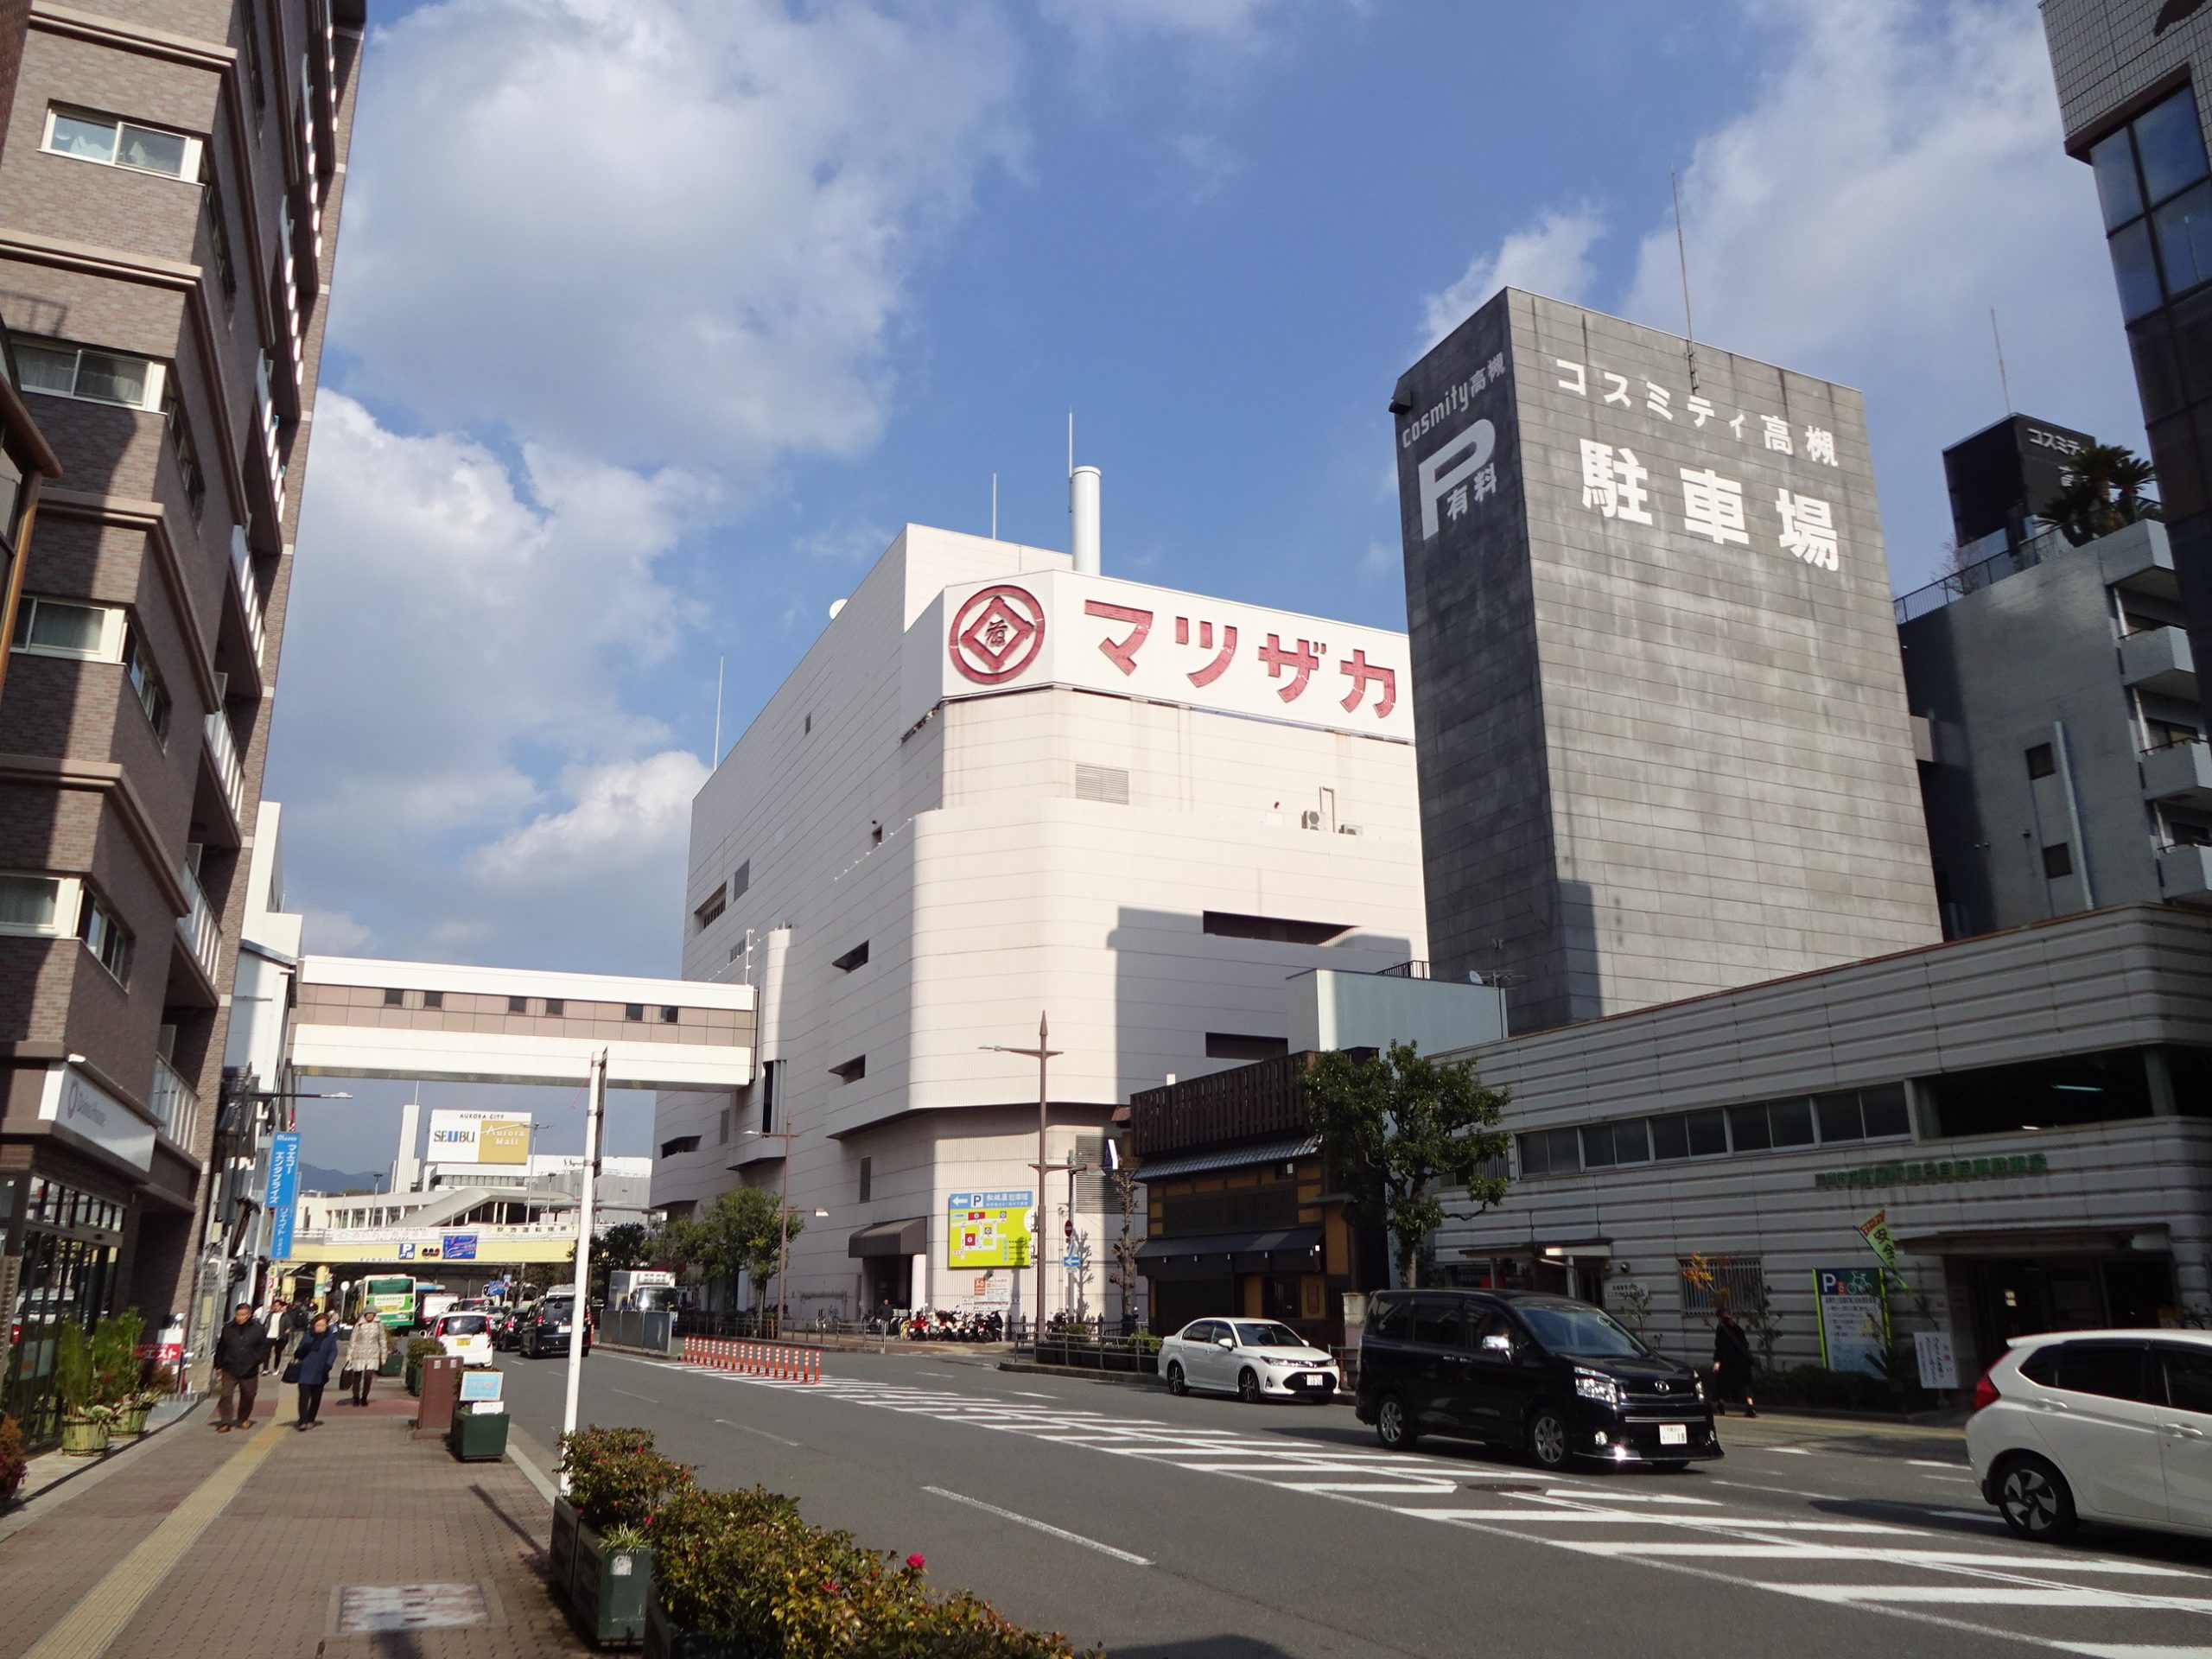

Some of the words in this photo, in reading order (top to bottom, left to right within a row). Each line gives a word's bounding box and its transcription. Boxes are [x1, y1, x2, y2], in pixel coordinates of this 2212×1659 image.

[1555, 358, 1839, 467] コスミティ高槻
[1417, 418, 1497, 541] P
[1446, 462, 1497, 521] 有料
[1579, 438, 1840, 572] 駐車場
[1084, 599, 1396, 719] マツザカ
[433, 1129, 475, 1143] SEIBU
[484, 1125, 525, 1137] Aurora
[974, 1195, 982, 1206] P
[402, 1243, 413, 1255] P
[1821, 1273, 1836, 1293] P
